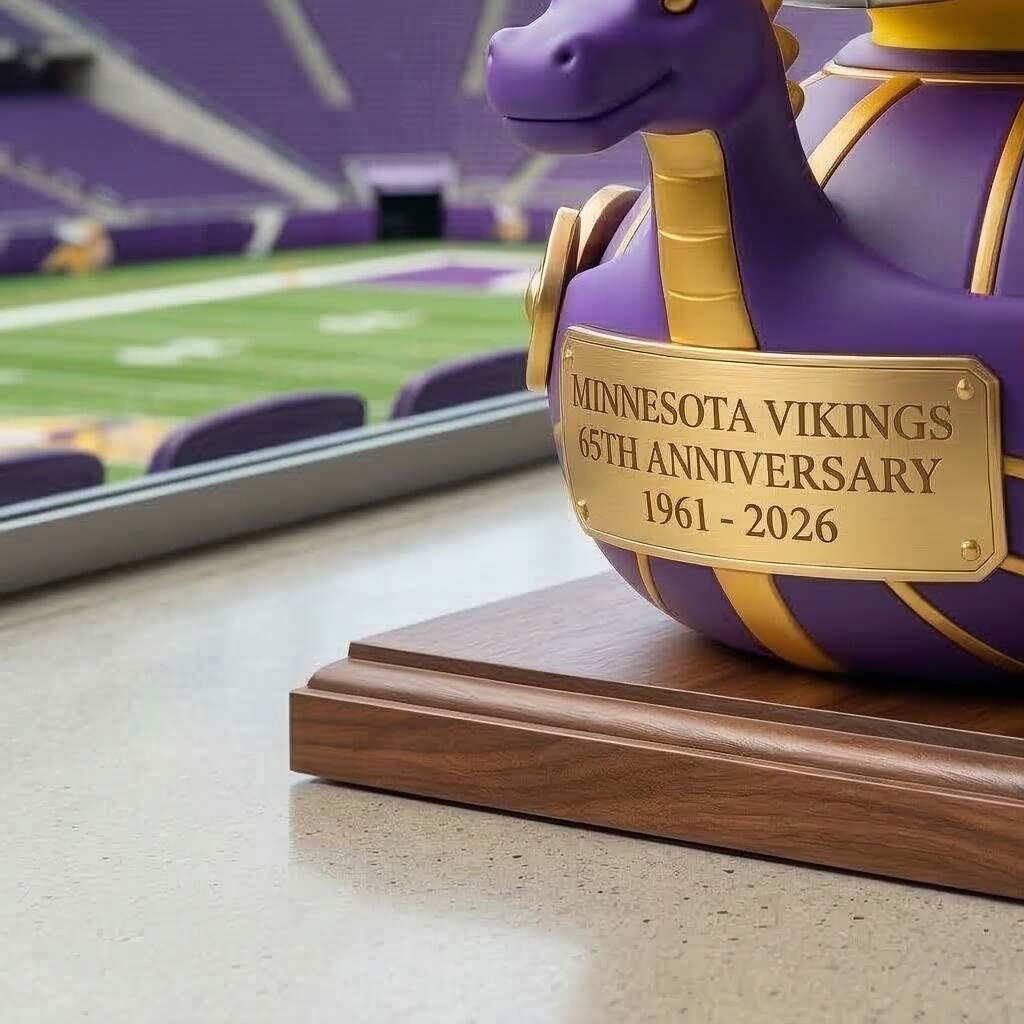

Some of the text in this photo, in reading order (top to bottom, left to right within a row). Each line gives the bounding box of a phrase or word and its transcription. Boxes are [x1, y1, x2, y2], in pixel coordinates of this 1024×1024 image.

[571, 373, 954, 441] MINNESOTA VIKINGS
[579, 426, 943, 494] 65TH ANNIVERSARY
[642, 489, 710, 532] 1961
[743, 503, 839, 544] 2026
